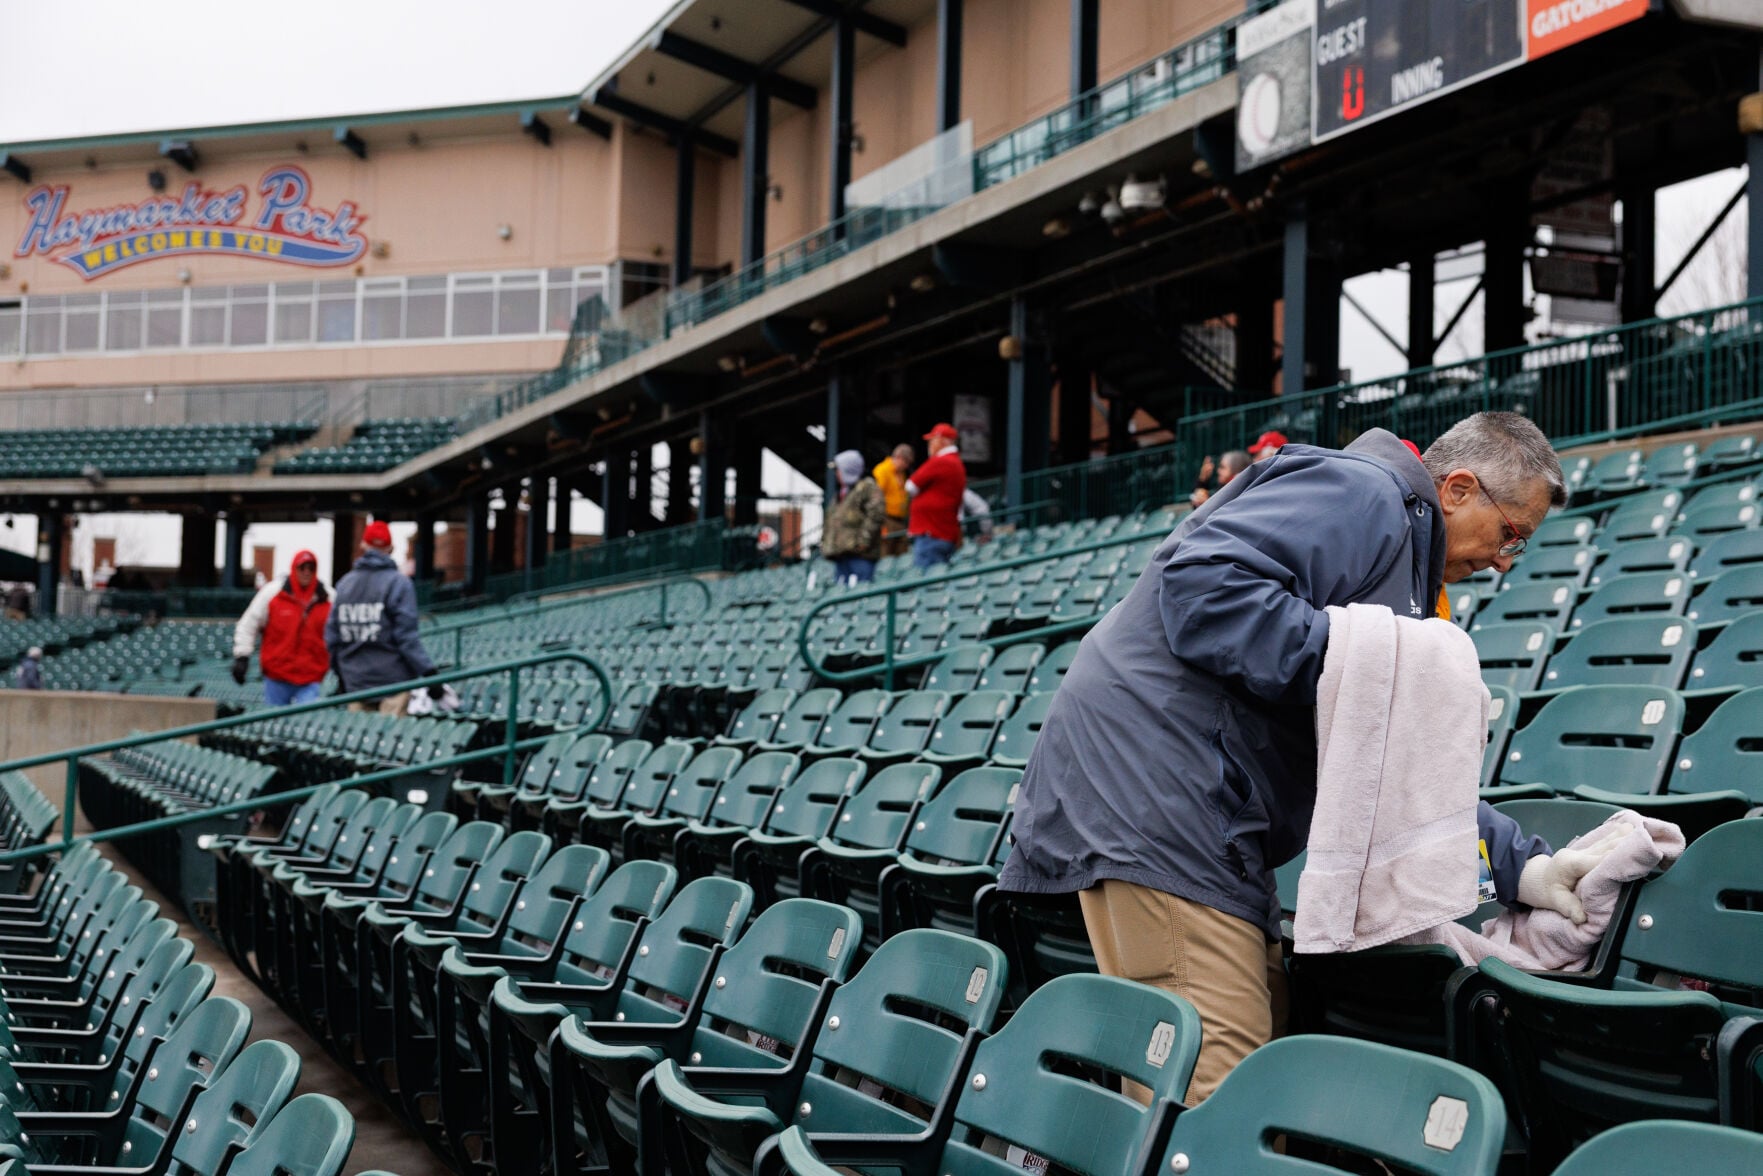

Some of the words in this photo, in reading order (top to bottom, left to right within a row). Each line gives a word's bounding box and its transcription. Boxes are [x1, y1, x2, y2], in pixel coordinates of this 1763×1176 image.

[1318, 16, 1367, 66] GUEST
[1391, 56, 1444, 104] INNING
[15, 181, 248, 258] Haymarket
[256, 165, 364, 246] Park
[84, 229, 224, 270] WELCOMES
[234, 234, 284, 256] YOU
[1153, 1030, 1171, 1058] 13
[1433, 1106, 1461, 1140] 14
